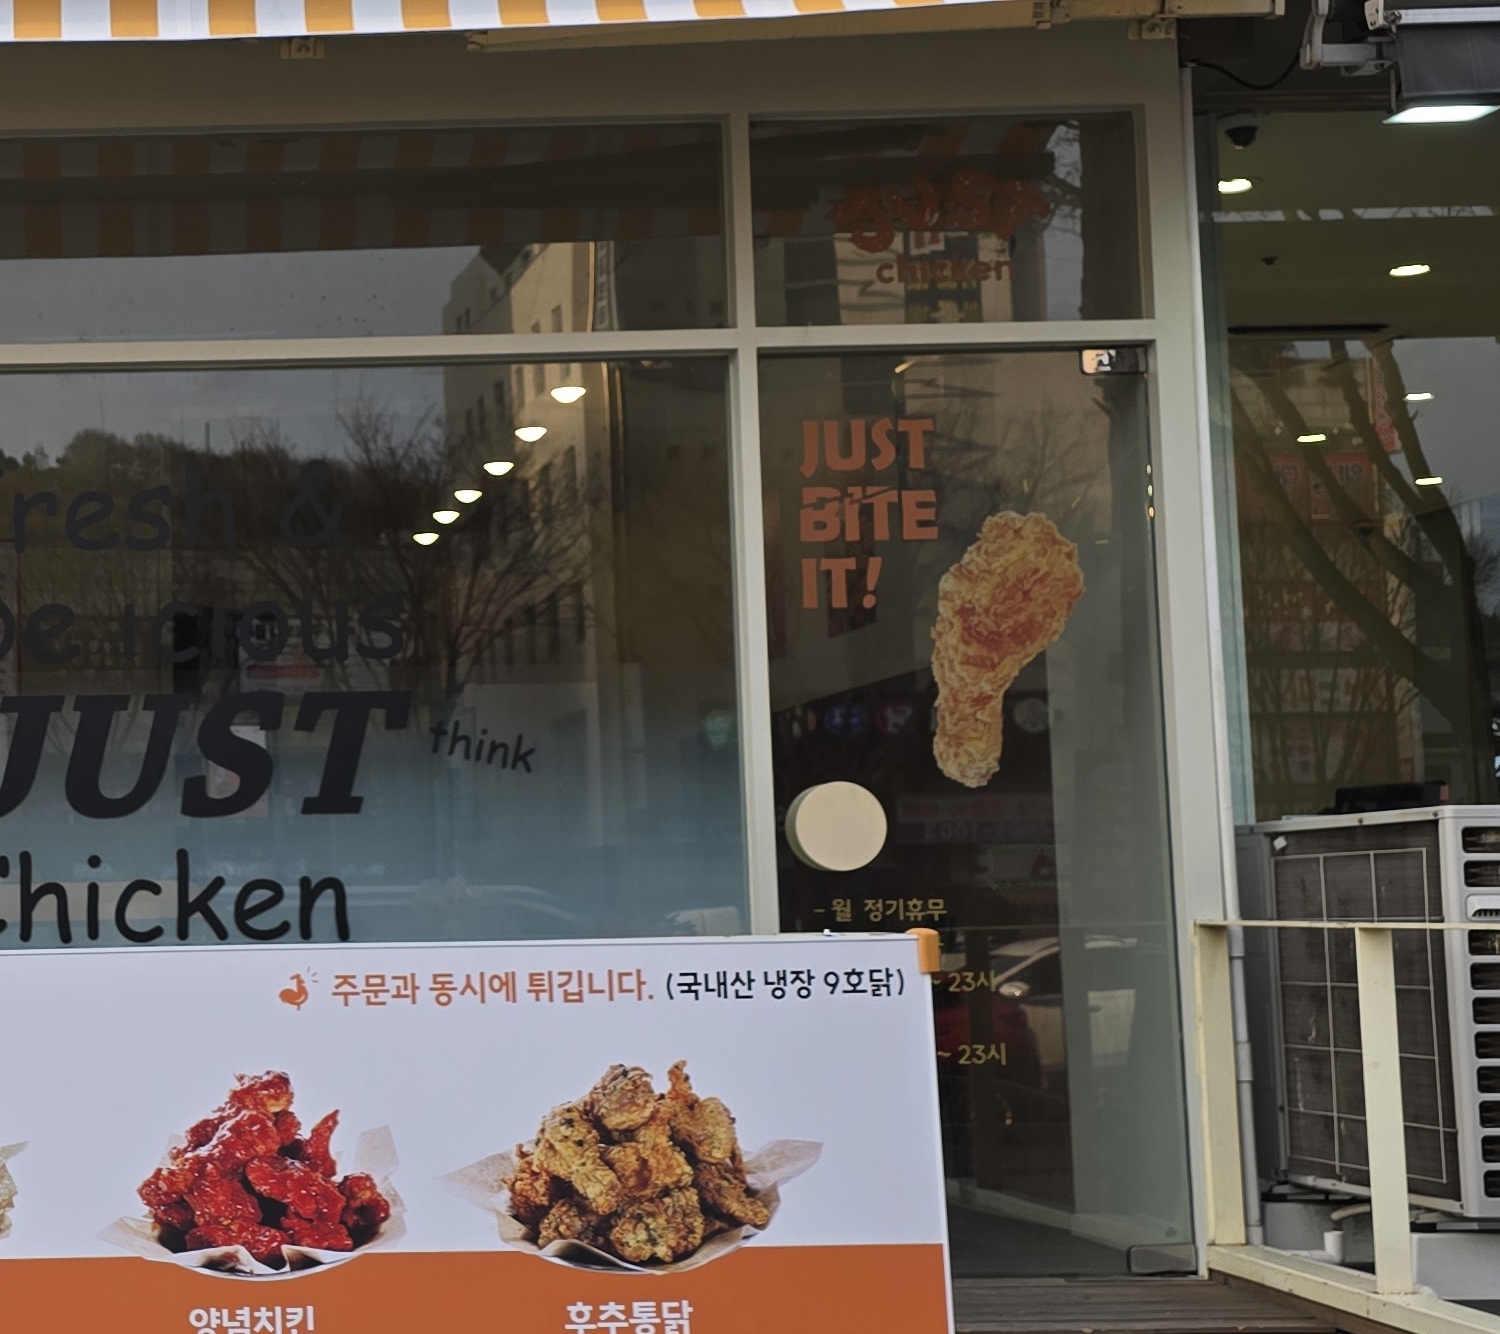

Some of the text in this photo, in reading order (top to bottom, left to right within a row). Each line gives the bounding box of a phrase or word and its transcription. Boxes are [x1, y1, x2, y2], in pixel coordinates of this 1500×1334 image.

[800, 419, 935, 477] JUST
[800, 557, 883, 610] IT!
[428, 719, 536, 775] think
[831, 899, 852, 922] 월
[864, 898, 947, 921] 정기휴무
[331, 973, 421, 1007] 주문과
[429, 971, 518, 1005] 동시에
[665, 969, 754, 1001] (국내산
[763, 967, 814, 999] 냉장
[823, 967, 905, 998] 9호닭)
[958, 1042, 1007, 1066] 23시
